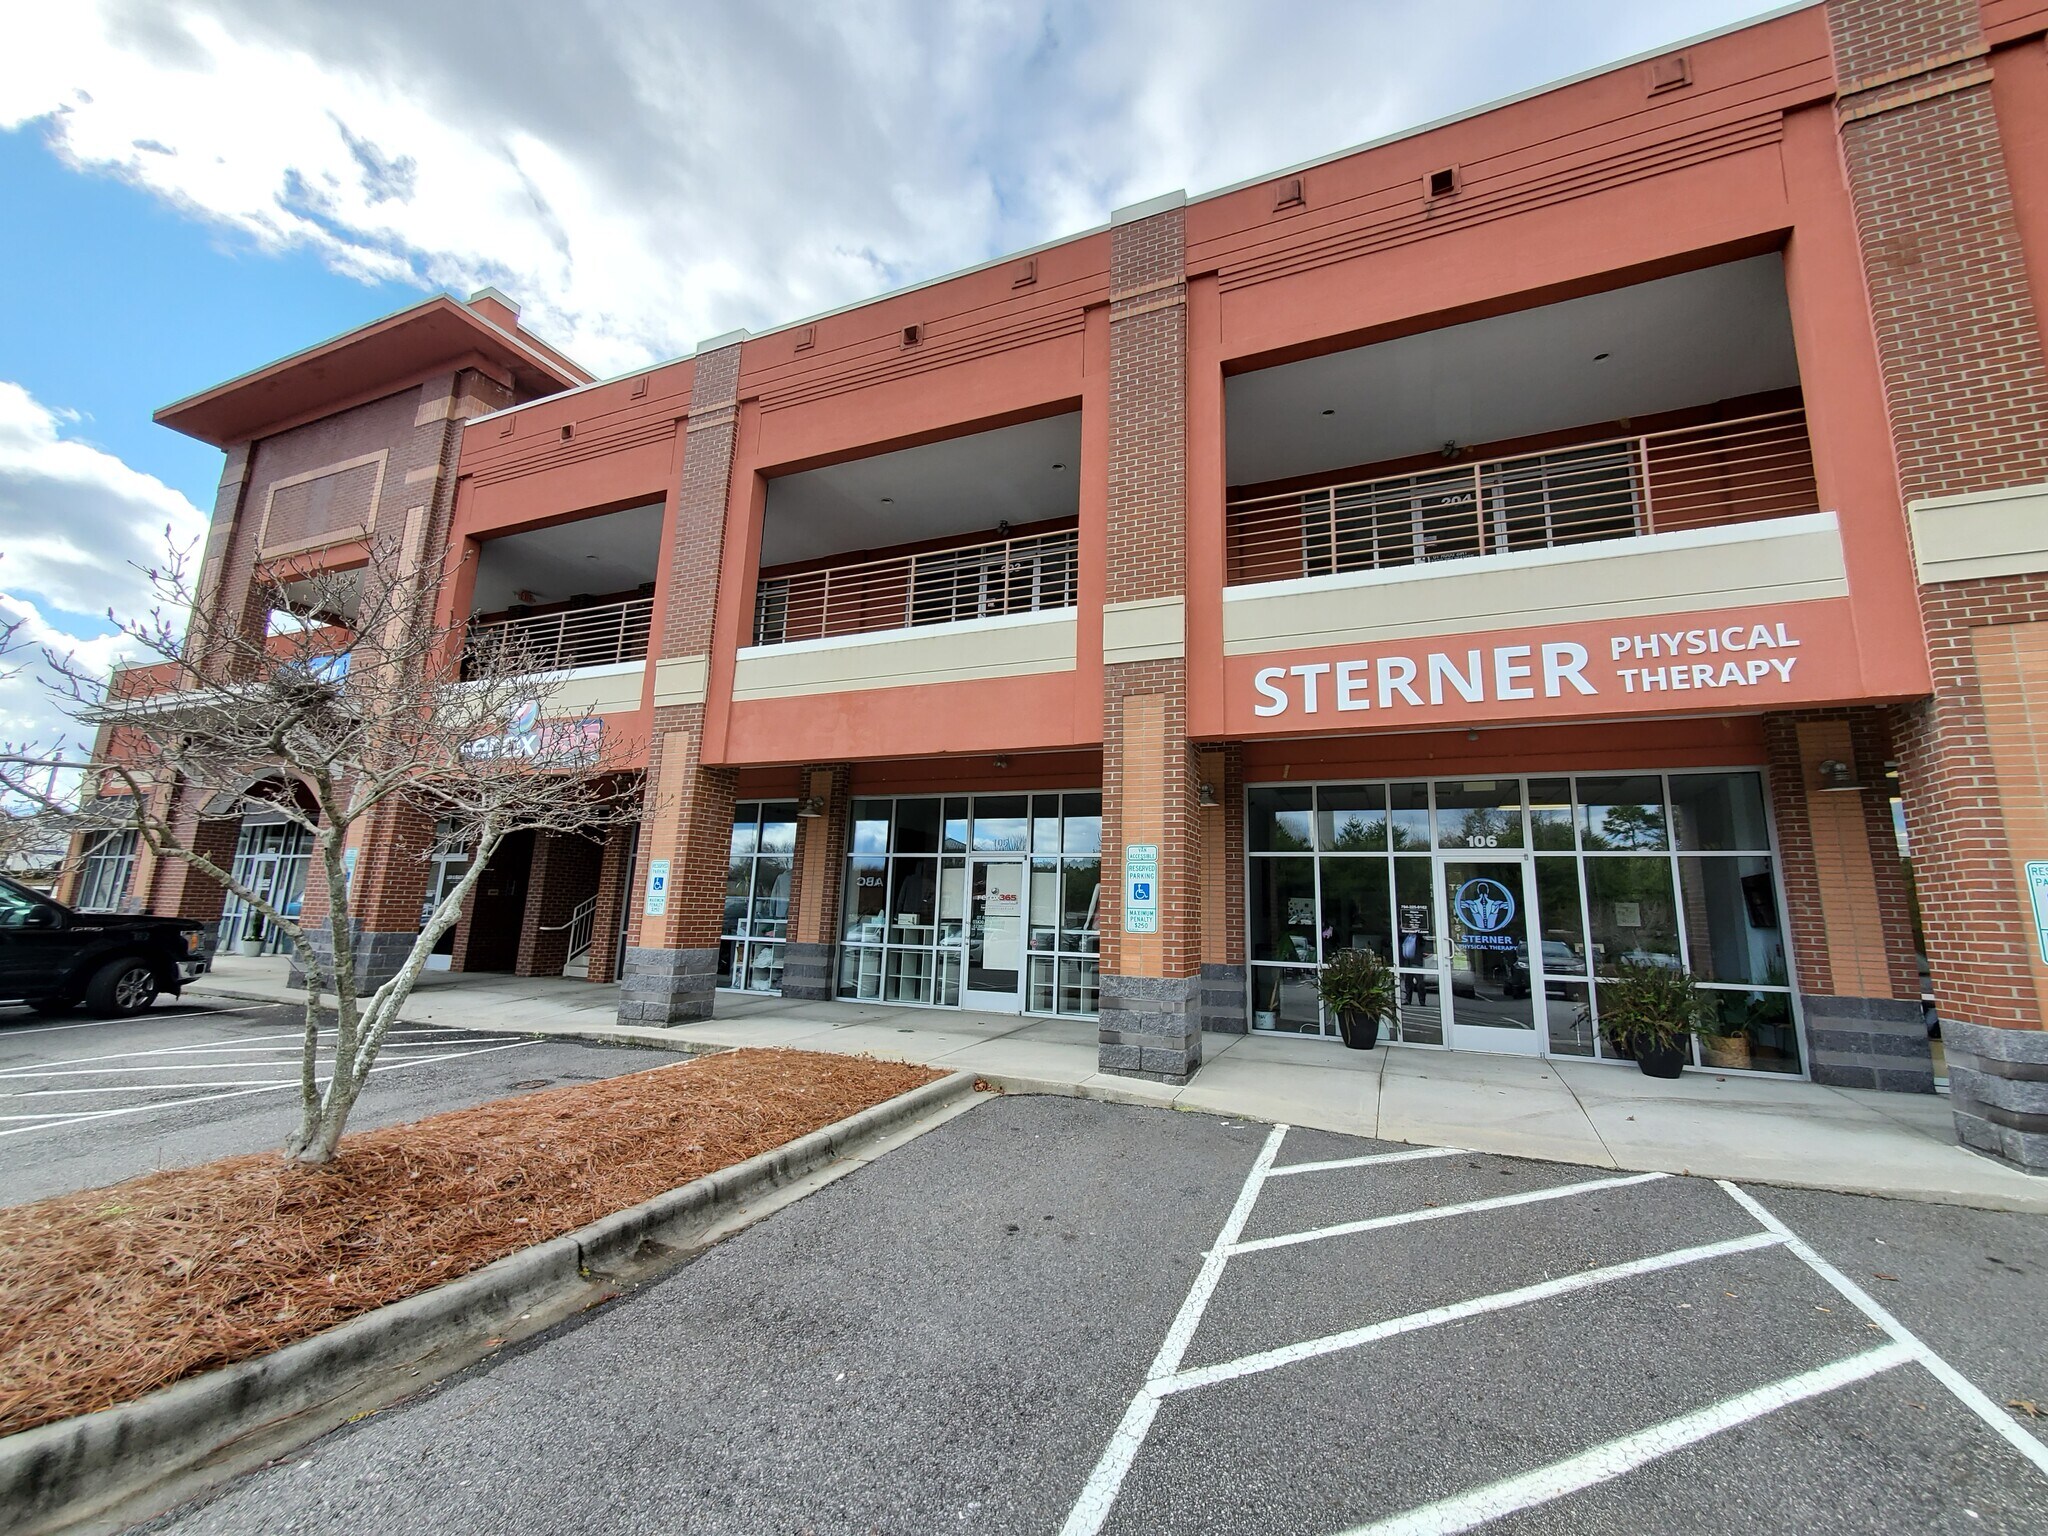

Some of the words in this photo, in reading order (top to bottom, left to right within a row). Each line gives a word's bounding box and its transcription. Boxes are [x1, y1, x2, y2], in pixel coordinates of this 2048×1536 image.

[1611, 622, 1801, 661] PHYSICAL
[1254, 641, 1599, 718] STERNER
[1617, 657, 1798, 694] THERAPY
[1466, 835, 1498, 848] 106
[1461, 934, 1513, 944] STERNER
